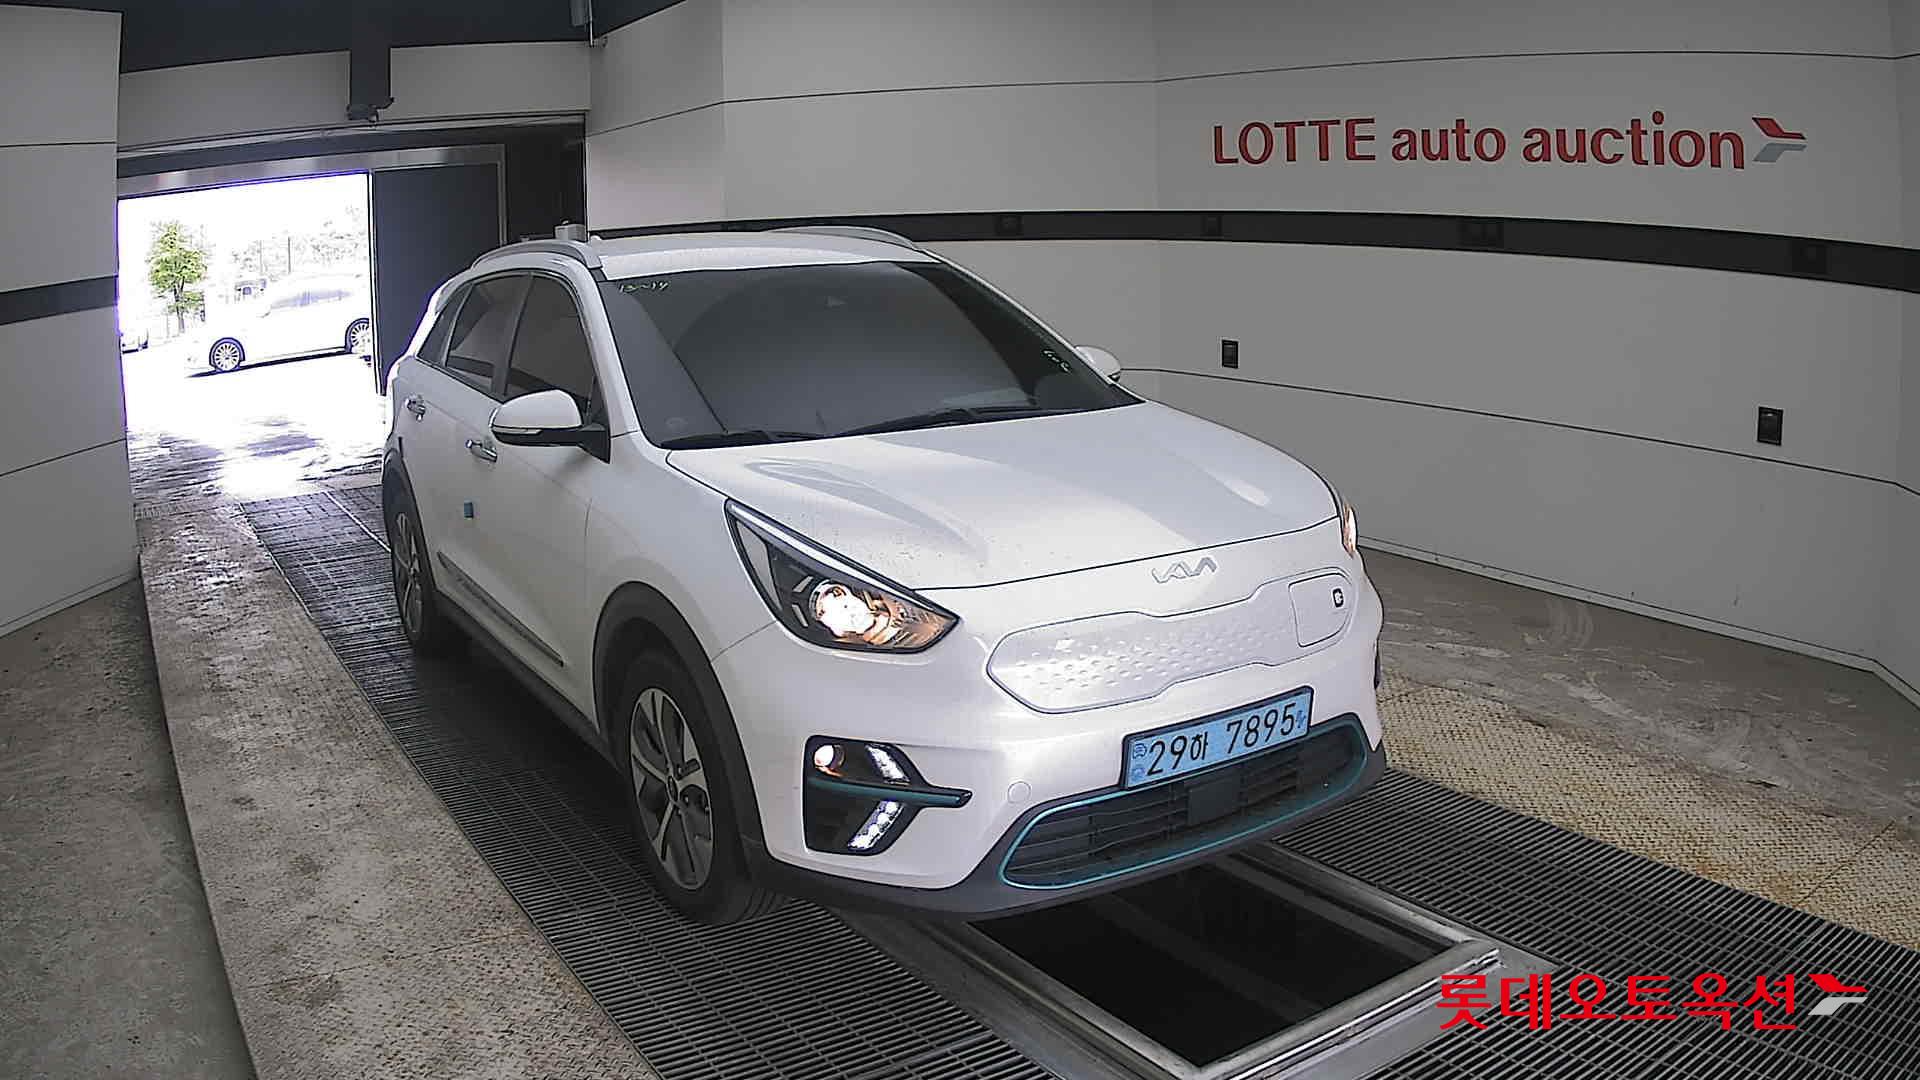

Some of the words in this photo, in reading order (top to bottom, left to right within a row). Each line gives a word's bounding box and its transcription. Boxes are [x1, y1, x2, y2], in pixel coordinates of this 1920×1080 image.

[1213, 117, 1376, 165] LOTTE
[1391, 118, 1506, 162] auto
[1522, 111, 1744, 169] auction
[1146, 731, 1208, 776] 29하
[1225, 702, 1297, 754] 7895
